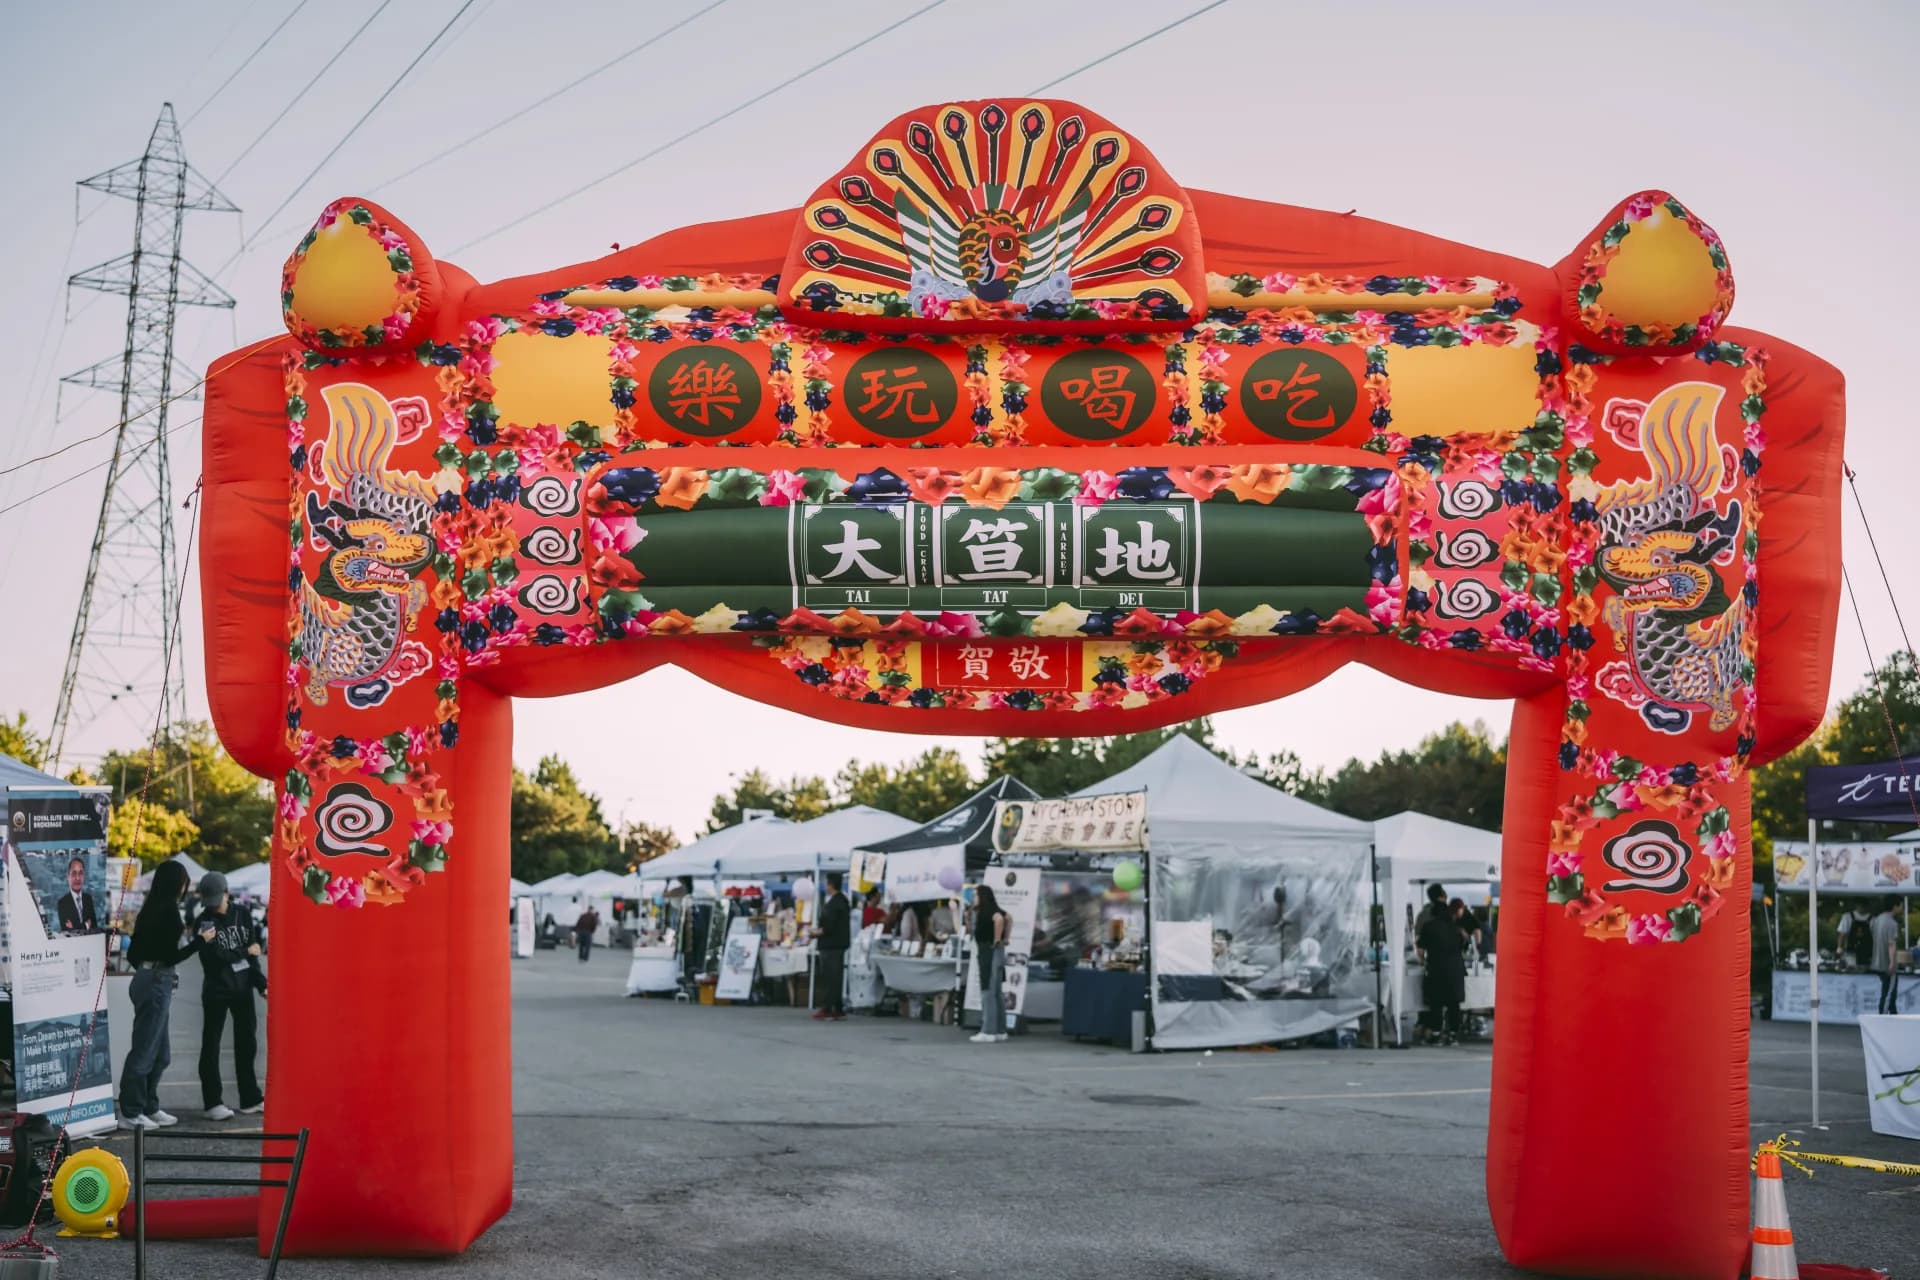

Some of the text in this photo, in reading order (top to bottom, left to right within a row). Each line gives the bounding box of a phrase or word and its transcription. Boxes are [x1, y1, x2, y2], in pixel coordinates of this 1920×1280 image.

[845, 589, 871, 604] TAI
[982, 589, 1009, 604] TAT
[1119, 592, 1144, 606] DEI
[20, 950, 60, 961] Henry Law
[23, 1034, 37, 1045] From
[38, 1031, 57, 1042] Dream
[57, 1029, 63, 1038] to
[26, 1046, 41, 1056] Make
[47, 1041, 69, 1055] Happen
